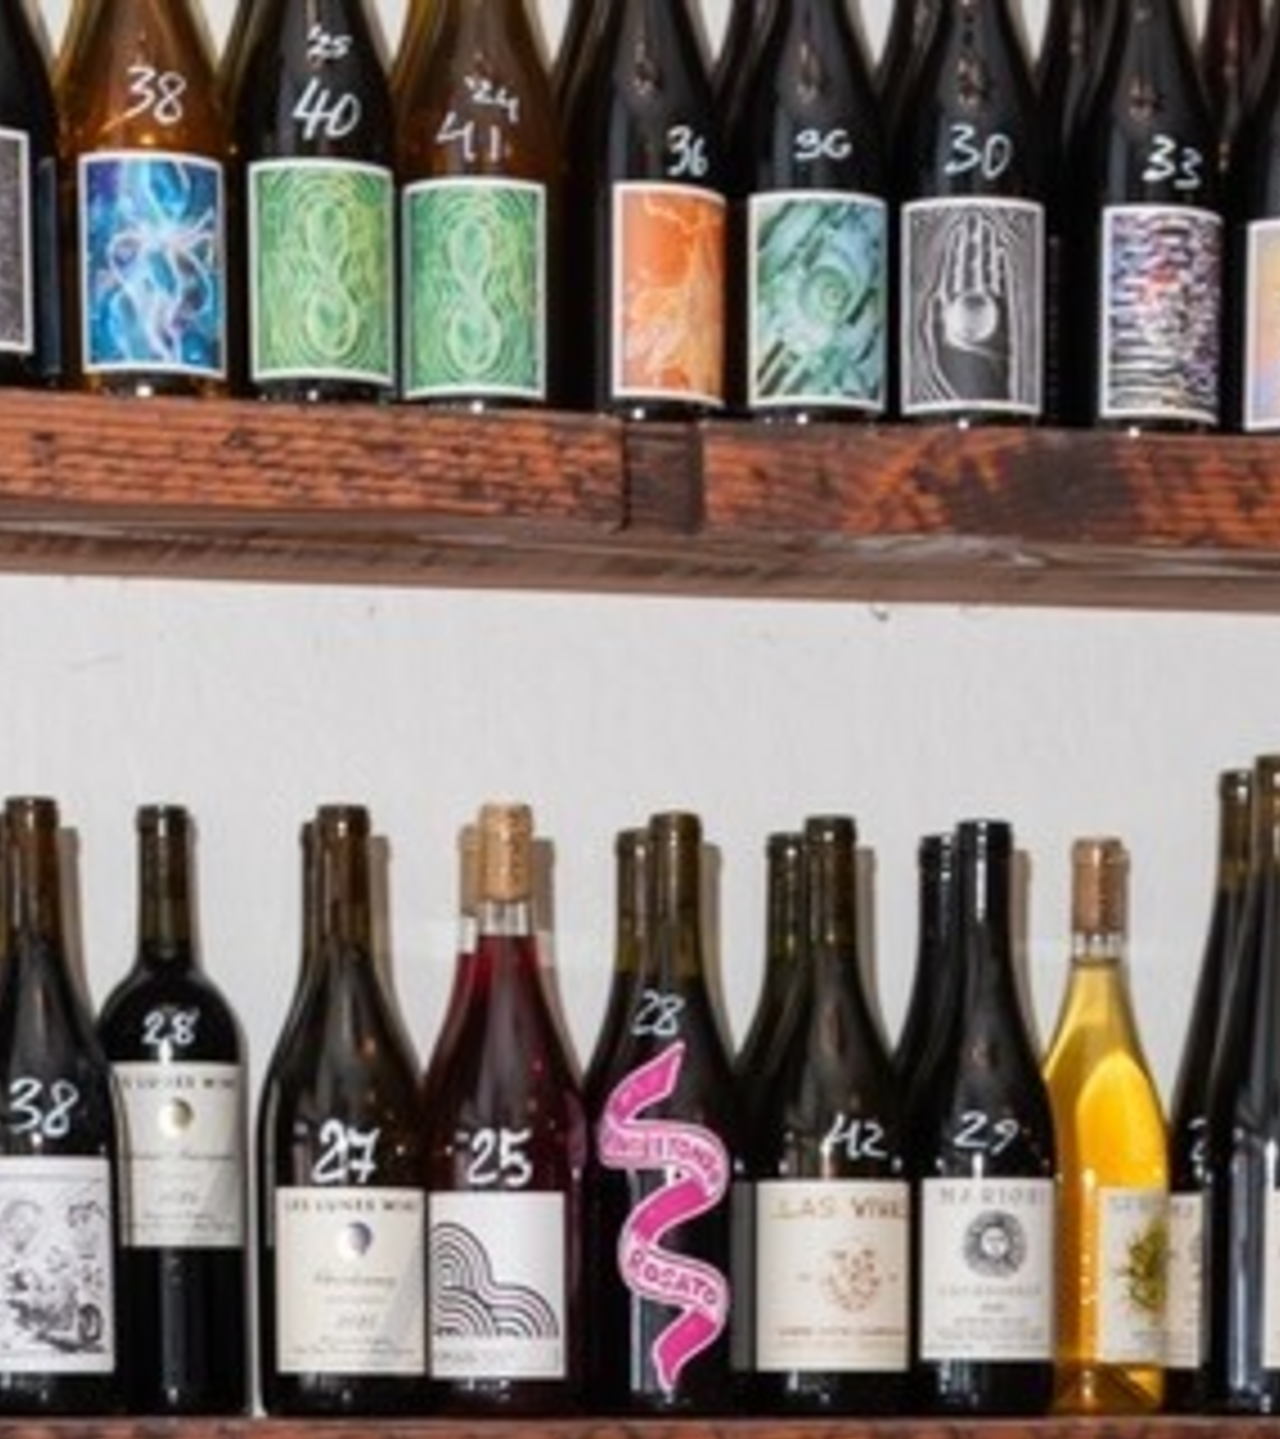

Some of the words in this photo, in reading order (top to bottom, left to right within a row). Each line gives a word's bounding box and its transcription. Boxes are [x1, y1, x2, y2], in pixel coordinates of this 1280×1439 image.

[125, 65, 186, 126] 38
[293, 77, 360, 140] 40
[667, 124, 709, 177] 36
[944, 123, 1011, 180] 30
[1142, 134, 1202, 189] 33
[631, 988, 687, 1036] 28
[9, 1077, 80, 1137] 38
[312, 1118, 380, 1185] 27
[468, 1127, 532, 1187] 25
